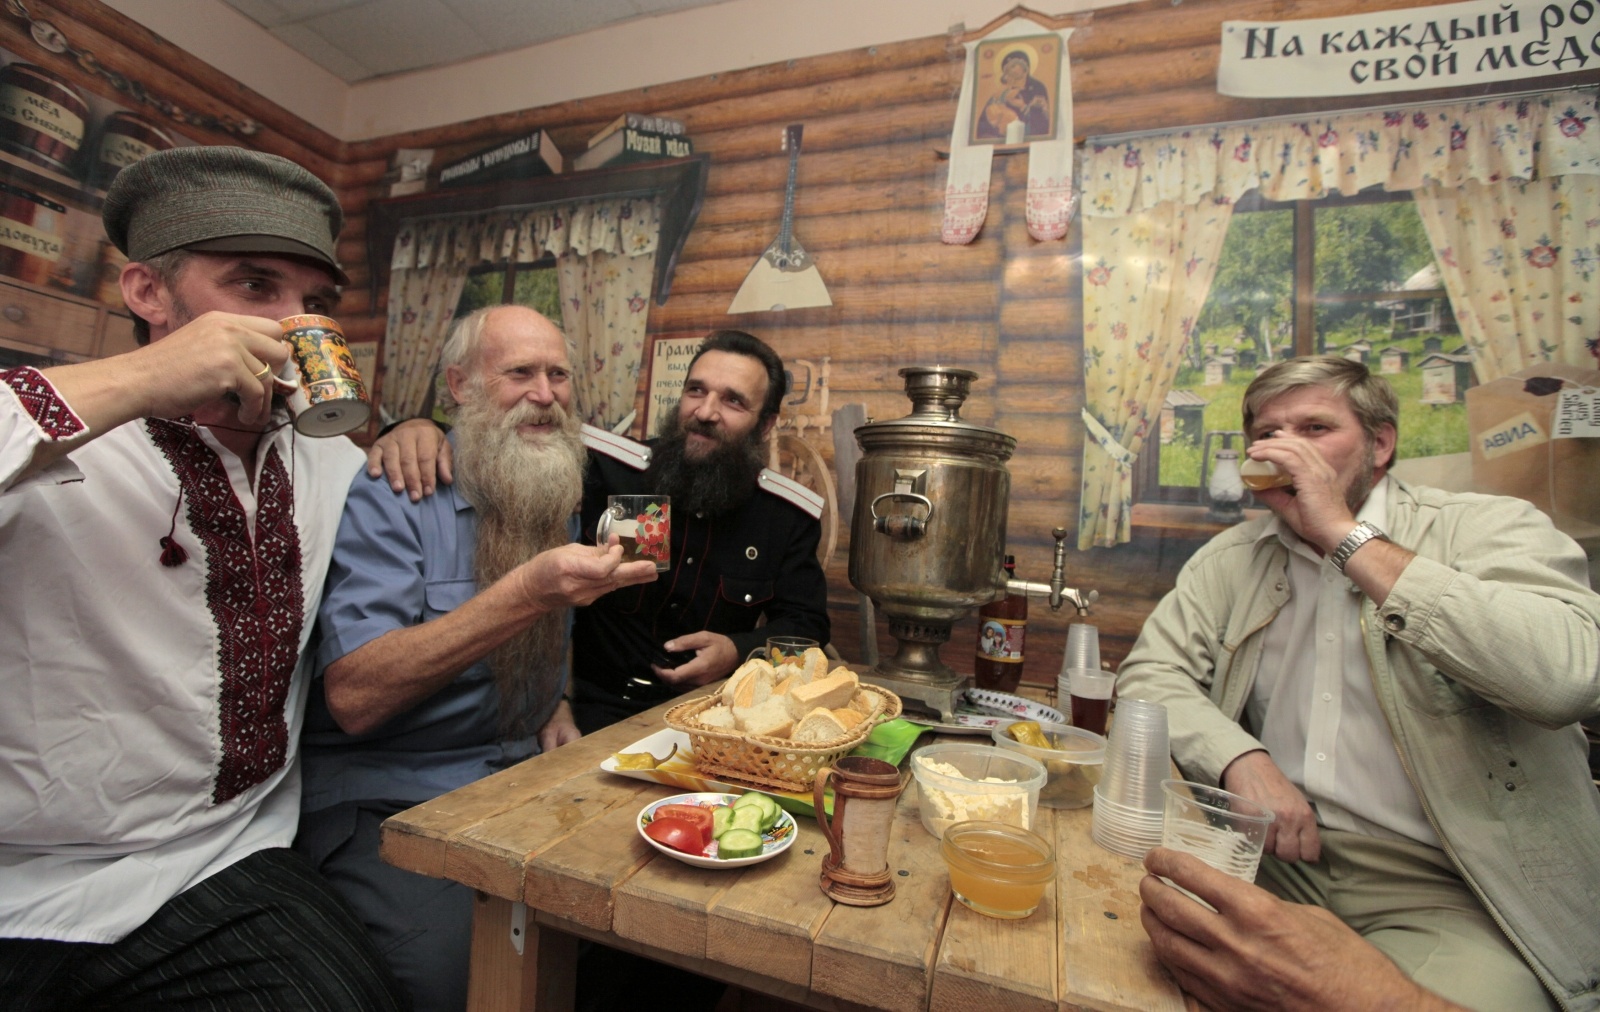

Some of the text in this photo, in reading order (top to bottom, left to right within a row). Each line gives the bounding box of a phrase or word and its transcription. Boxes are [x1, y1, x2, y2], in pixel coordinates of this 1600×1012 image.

[1240, 0, 1600, 59] На каждый ро
[1350, 43, 1457, 83] свой
[667, 362, 688, 372] выд
